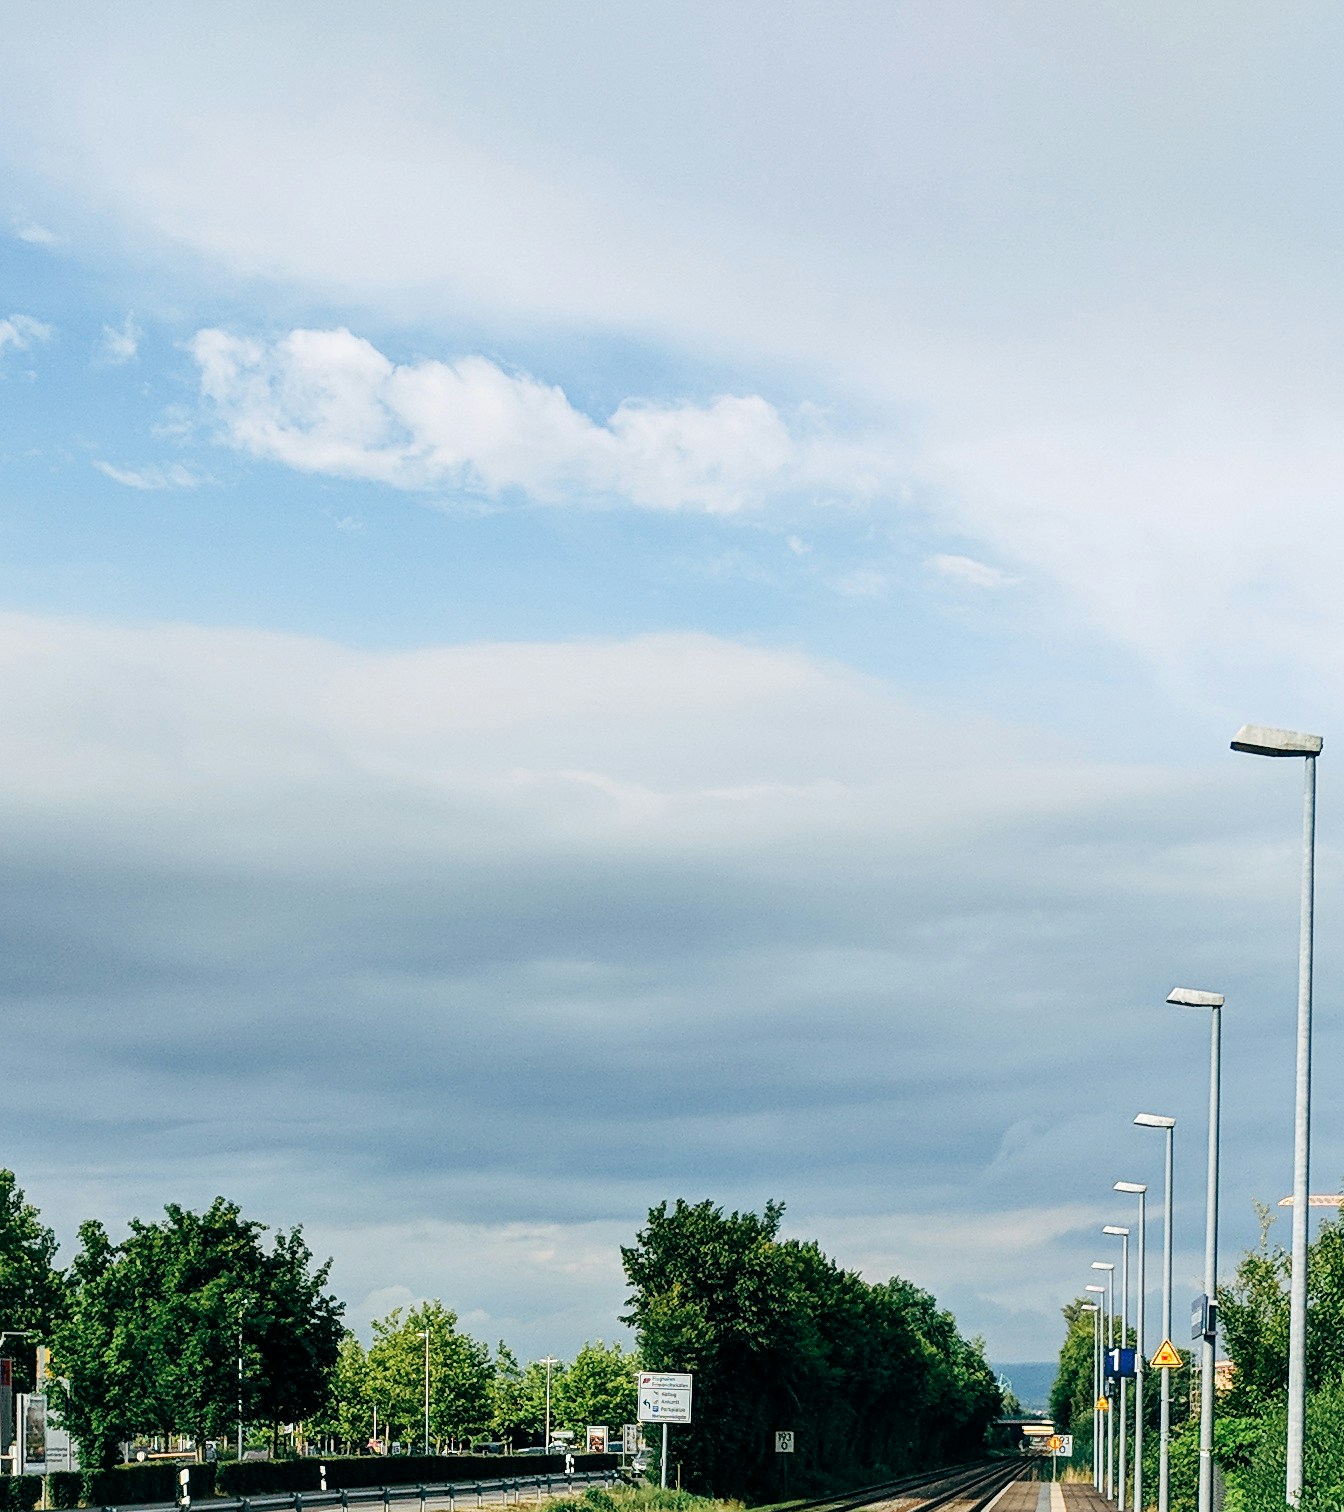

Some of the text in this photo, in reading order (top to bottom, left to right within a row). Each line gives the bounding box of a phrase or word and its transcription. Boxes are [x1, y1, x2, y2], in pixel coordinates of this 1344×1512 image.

[1109, 1349, 1119, 1371] 1
[778, 1432, 791, 1441] 193
[781, 1442, 787, 1450] 0
